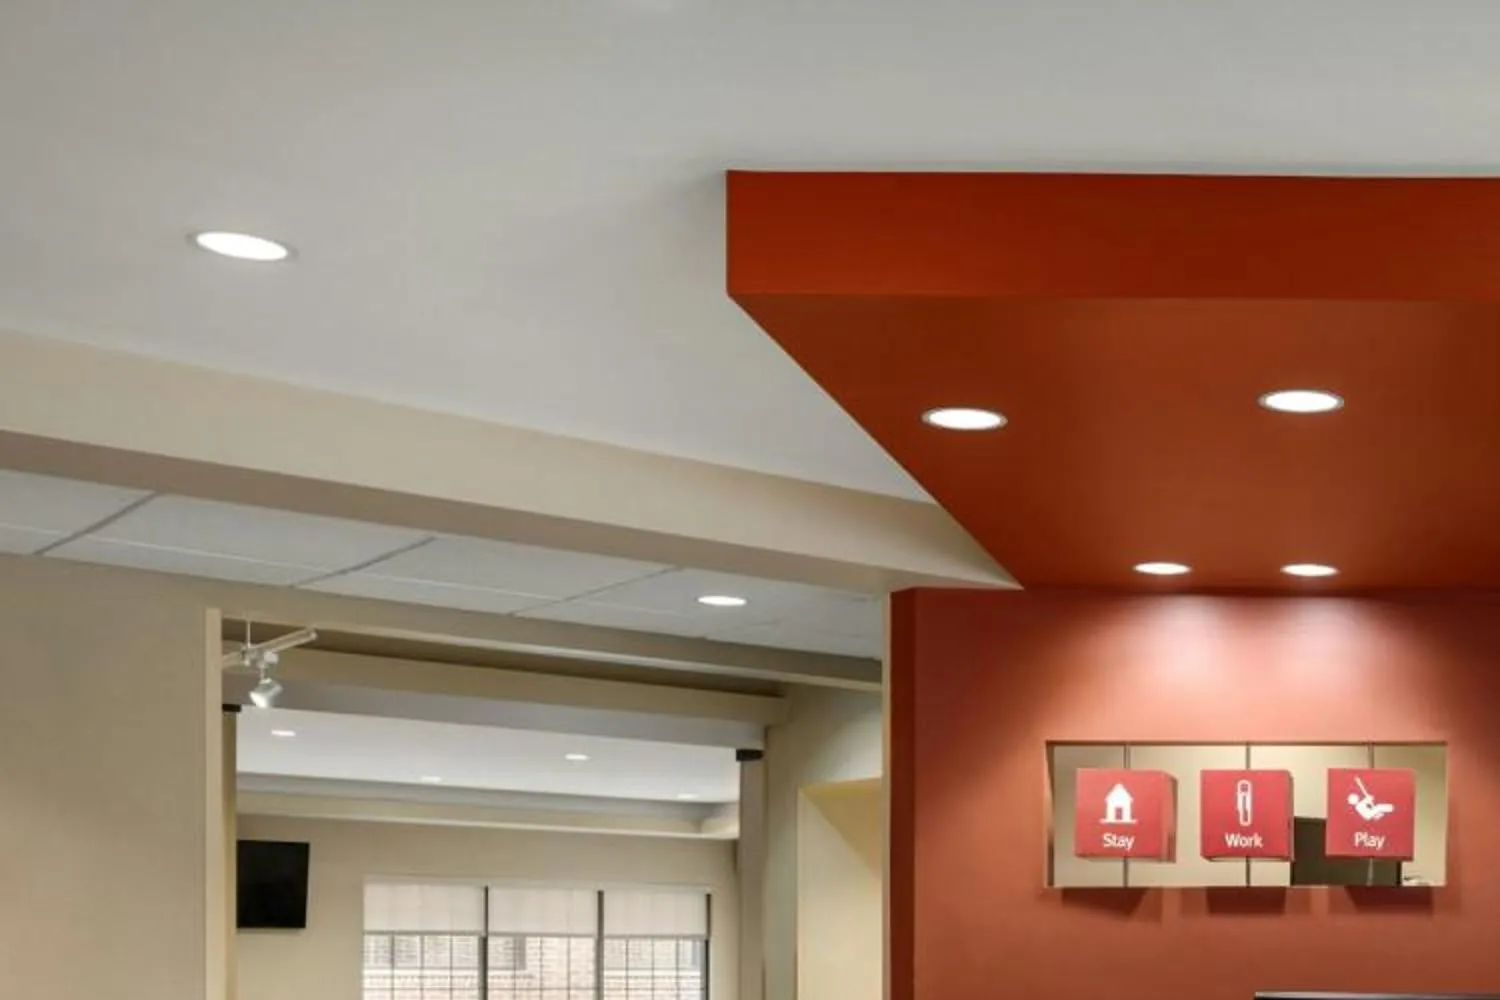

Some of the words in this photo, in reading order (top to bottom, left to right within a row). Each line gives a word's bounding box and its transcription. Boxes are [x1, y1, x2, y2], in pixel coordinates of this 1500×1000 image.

[1103, 832, 1134, 850] Stay
[1225, 832, 1263, 848] Work
[1354, 832, 1385, 850] Play
